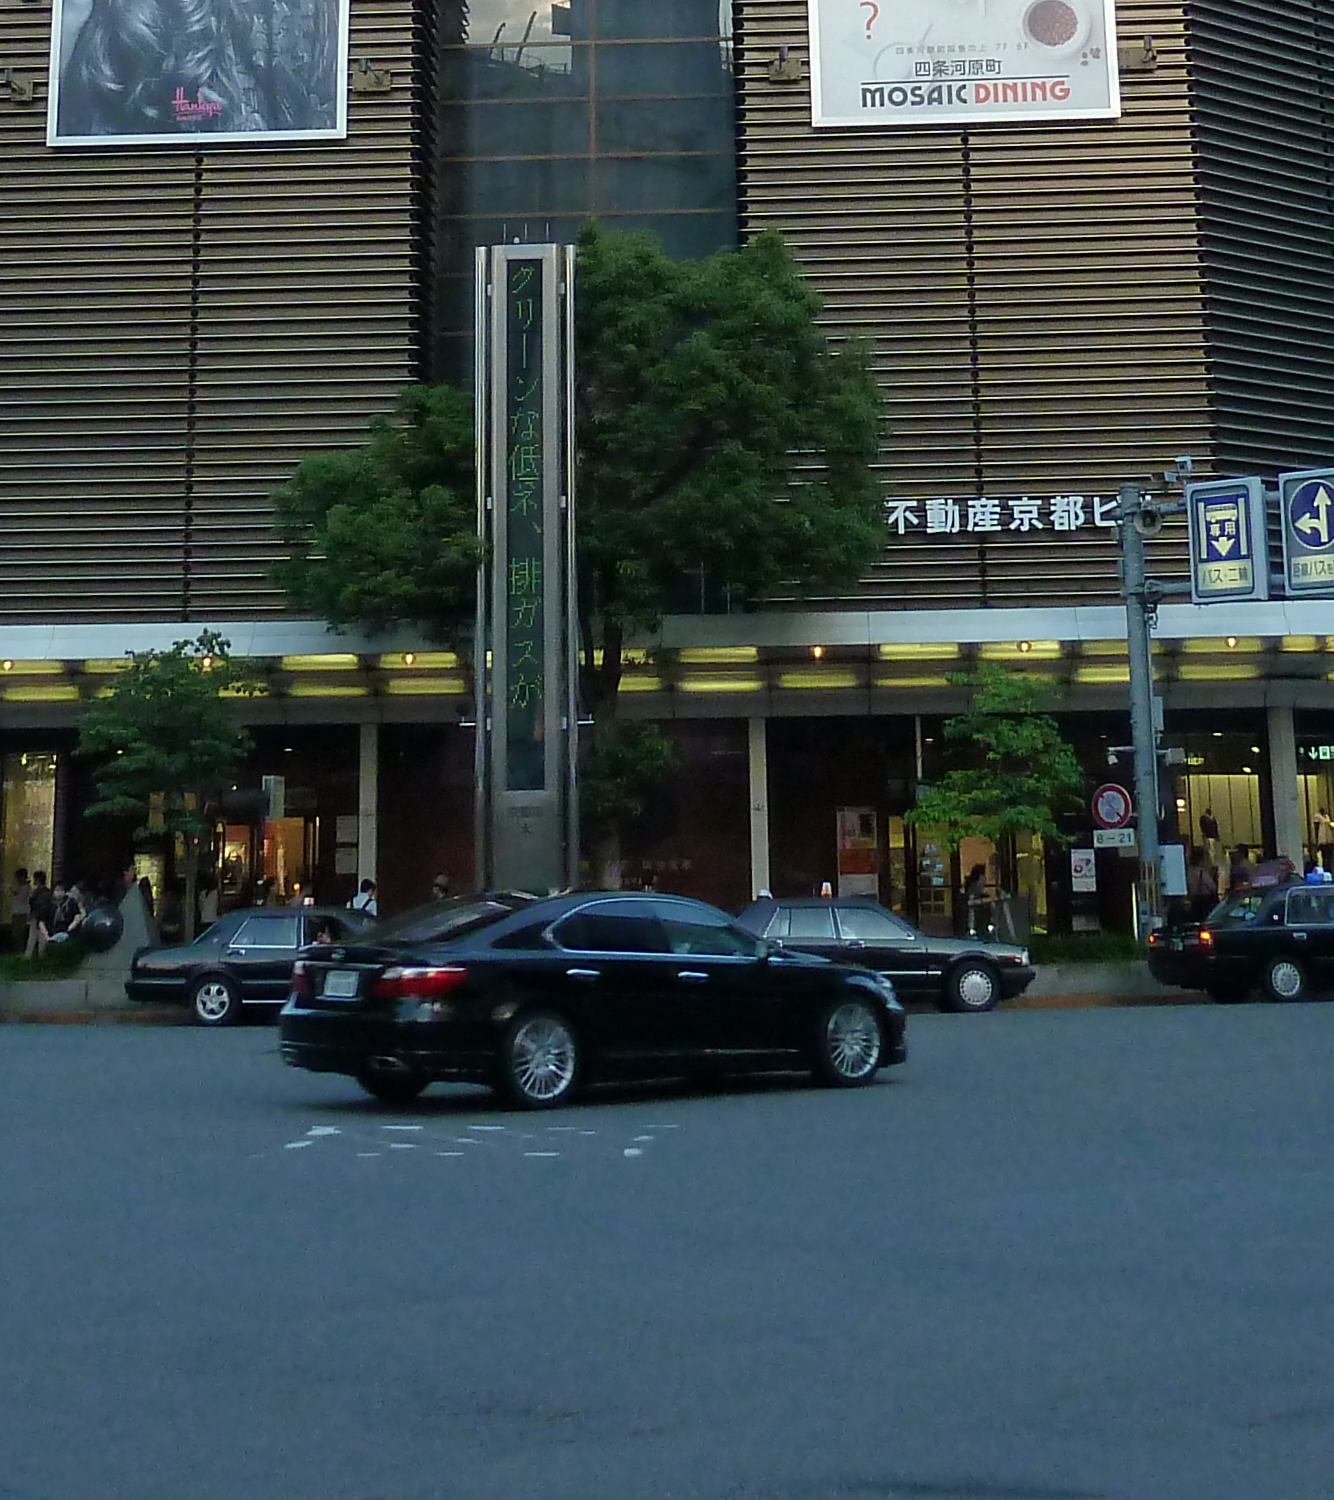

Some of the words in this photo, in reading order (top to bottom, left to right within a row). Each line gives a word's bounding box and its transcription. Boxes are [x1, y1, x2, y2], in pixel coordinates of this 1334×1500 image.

[914, 58, 1003, 78] 四条河原町
[861, 84, 968, 108] MOSAIC
[974, 79, 1071, 104] DINING
[886, 495, 1152, 536] 不動産京都ビ
[1209, 521, 1236, 537] 専用
